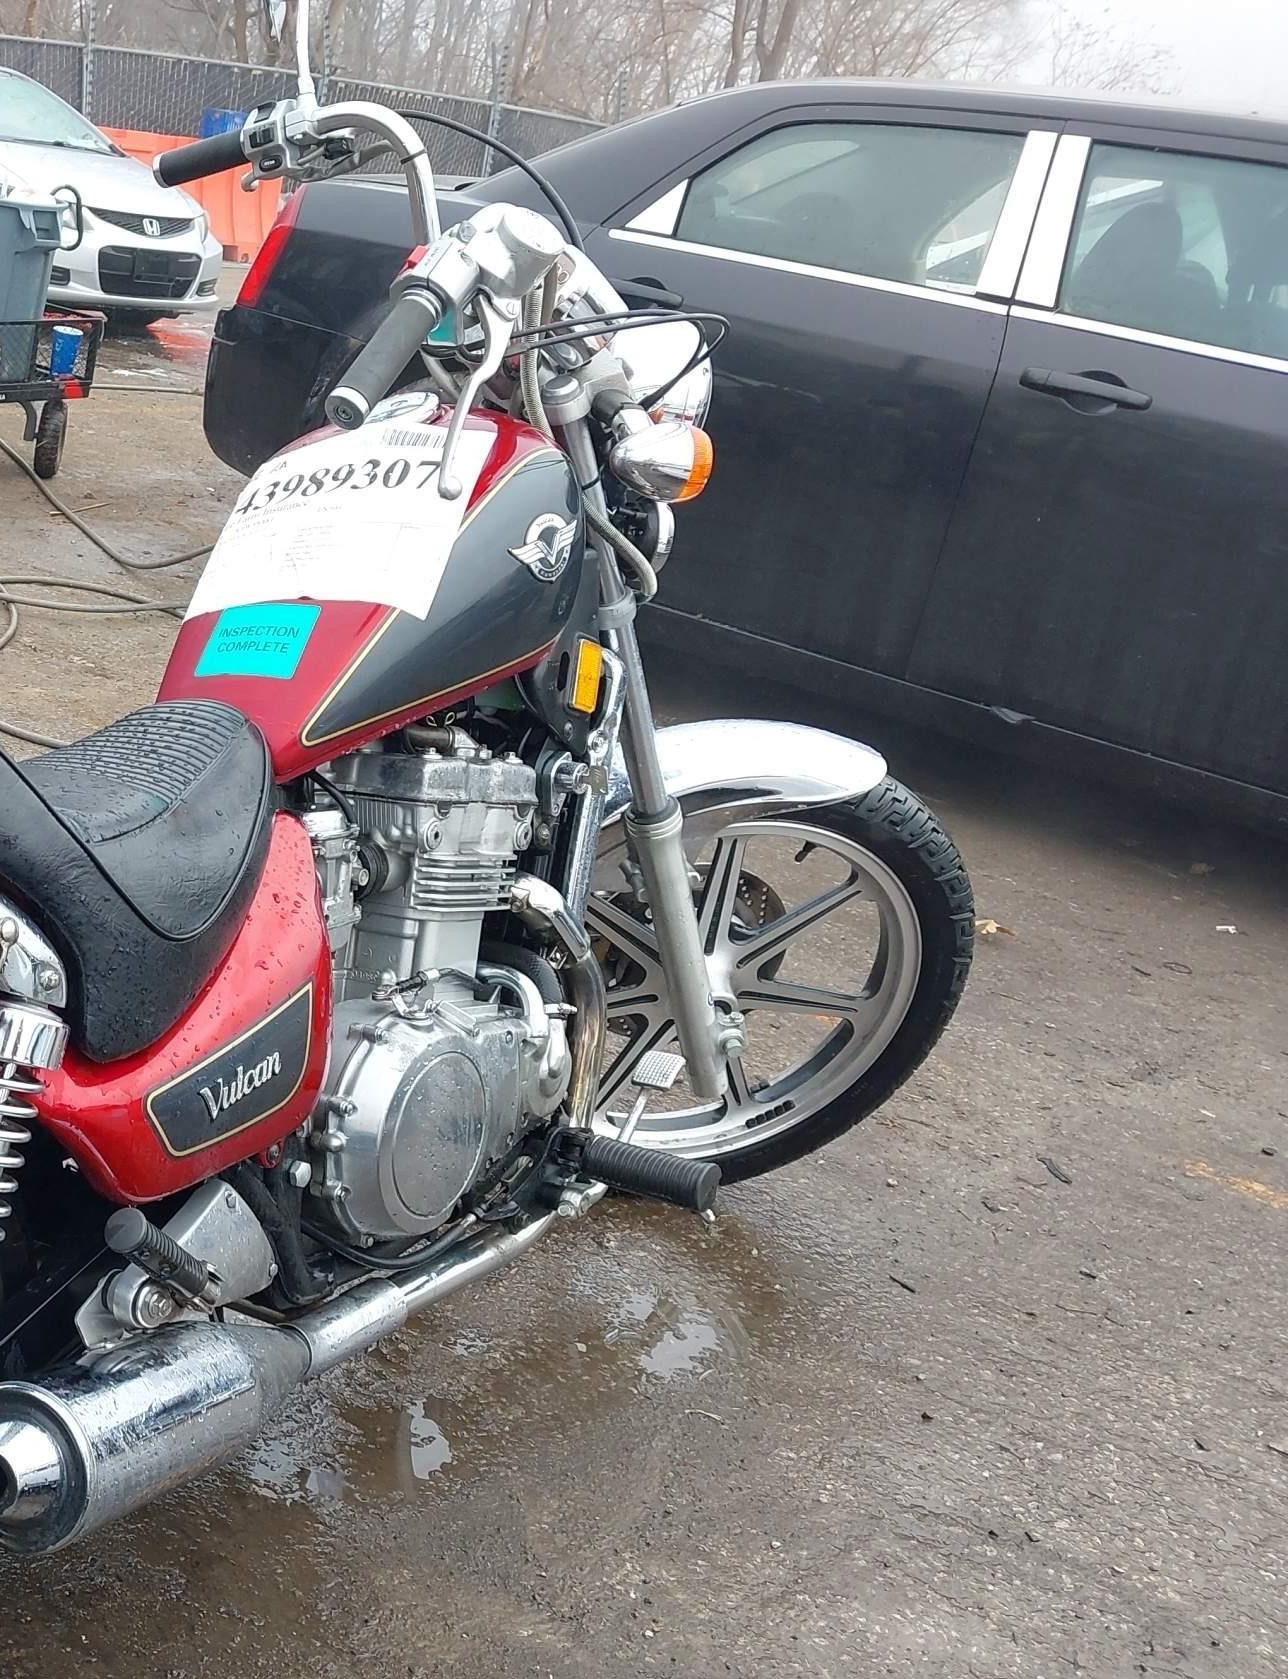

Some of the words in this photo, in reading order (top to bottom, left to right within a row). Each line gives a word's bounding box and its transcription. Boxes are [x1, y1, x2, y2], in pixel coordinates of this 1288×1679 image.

[235, 458, 443, 515] 43989307
[216, 641, 291, 654] COMPLETE
[218, 625, 300, 639] INSPECTION
[198, 1050, 282, 1120] Vulcan
